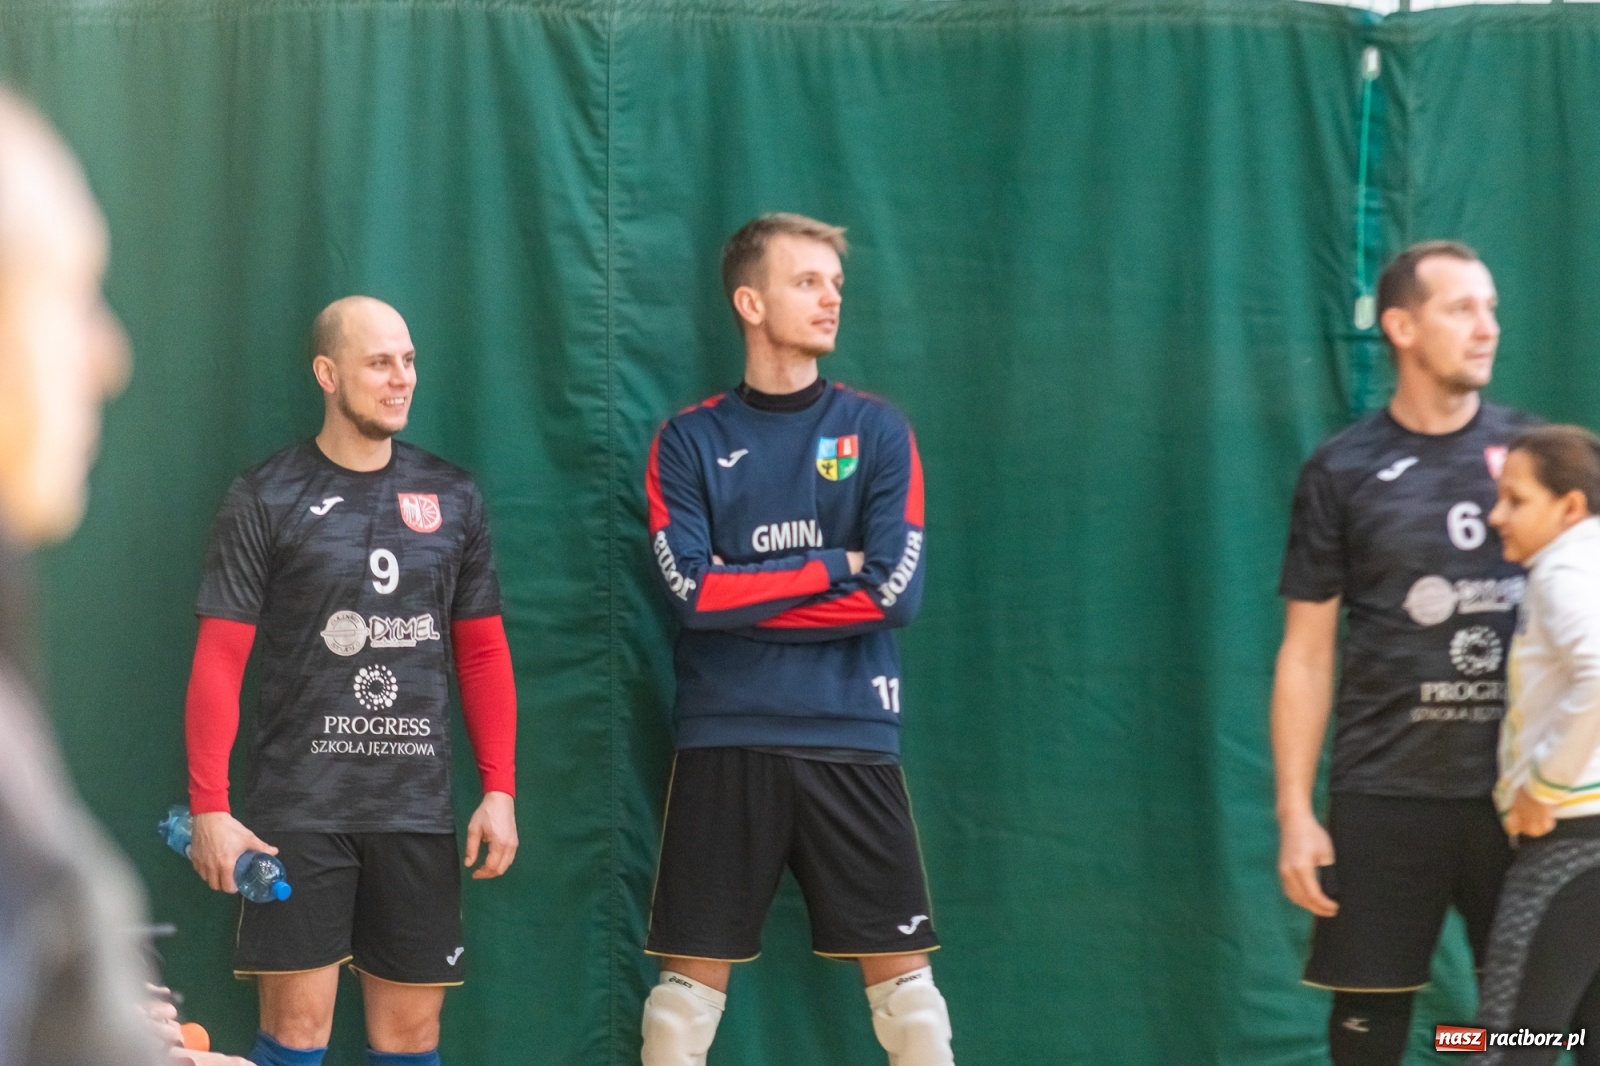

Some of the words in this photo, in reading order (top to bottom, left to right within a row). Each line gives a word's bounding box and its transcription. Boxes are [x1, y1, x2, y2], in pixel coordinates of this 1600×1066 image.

[1447, 501, 1487, 551] 6
[369, 548, 400, 595] 9
[369, 613, 440, 641] DYMEL
[871, 675, 900, 714] 11
[323, 715, 431, 736] PROGRESS
[310, 740, 365, 754] SZKOŁA
[367, 741, 435, 756] JĘZYKOWA
